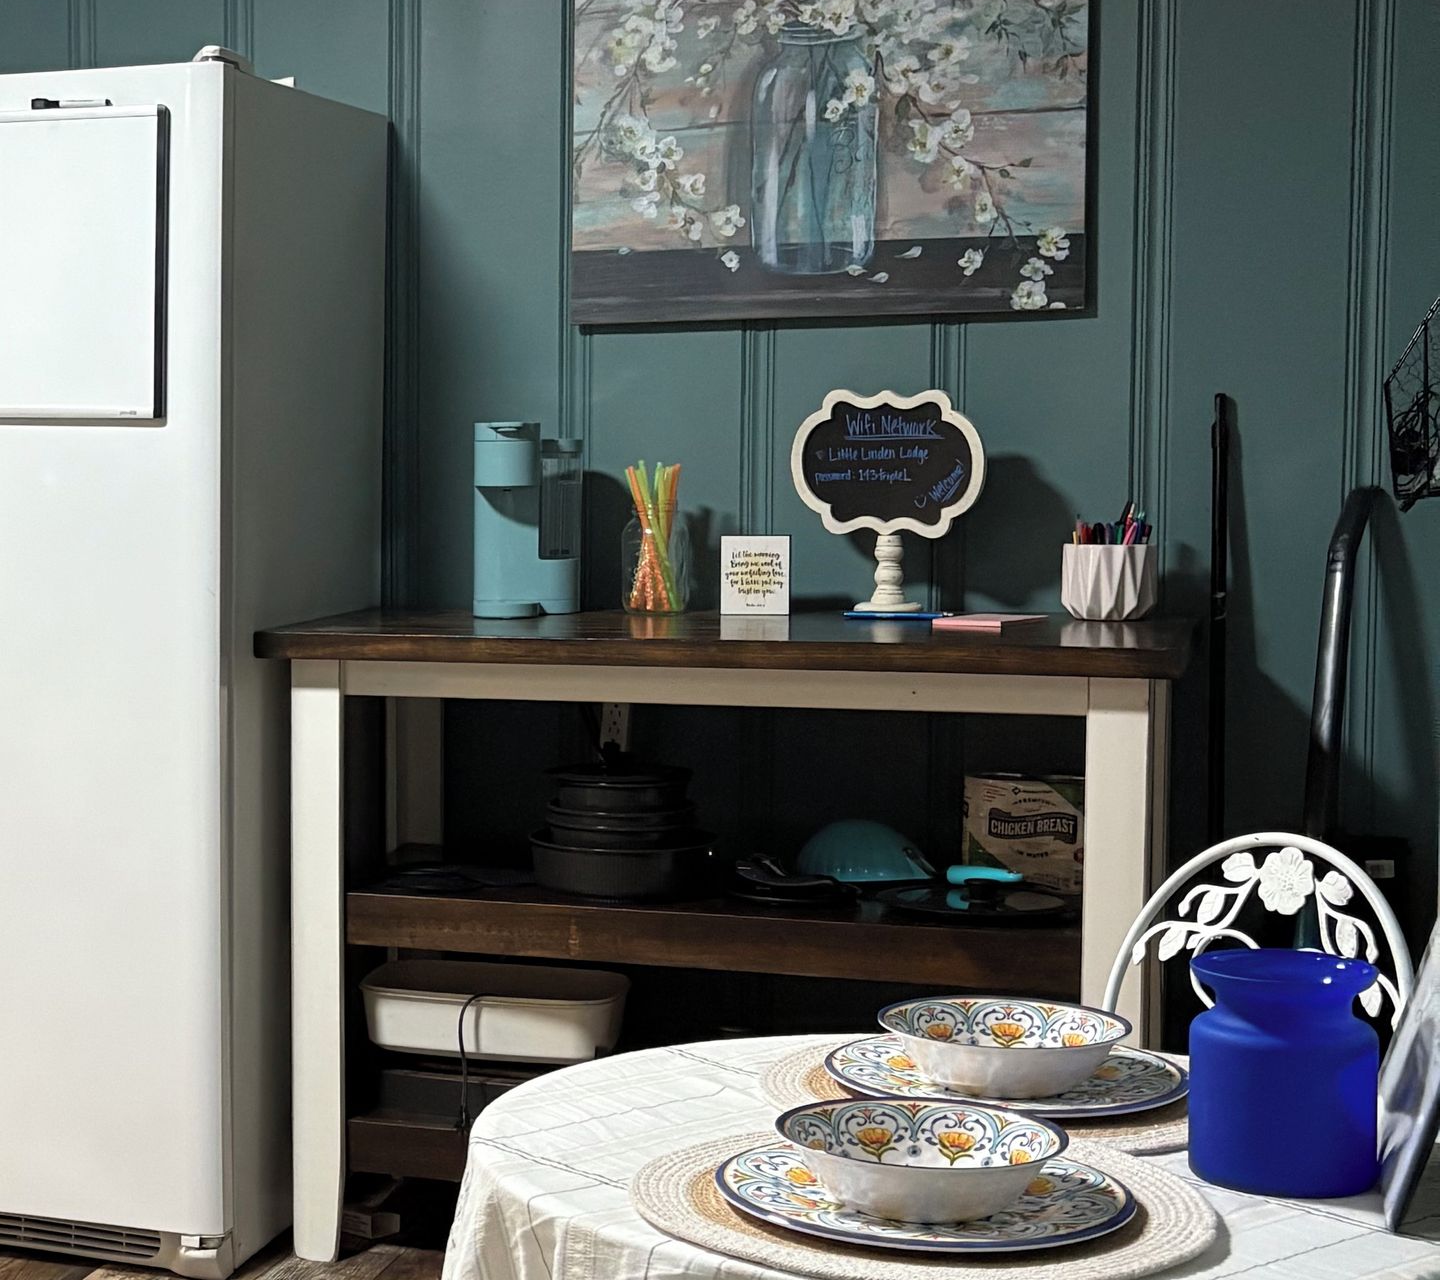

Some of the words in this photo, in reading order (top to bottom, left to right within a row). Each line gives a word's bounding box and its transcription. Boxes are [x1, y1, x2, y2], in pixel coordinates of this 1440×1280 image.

[881, 415, 937, 436] Network
[828, 447, 858, 461] Little
[861, 446, 896, 460] Linden
[900, 445, 929, 464] Lodge
[990, 819, 1035, 836] CHICKEN
[1036, 818, 1075, 834] BREAST
